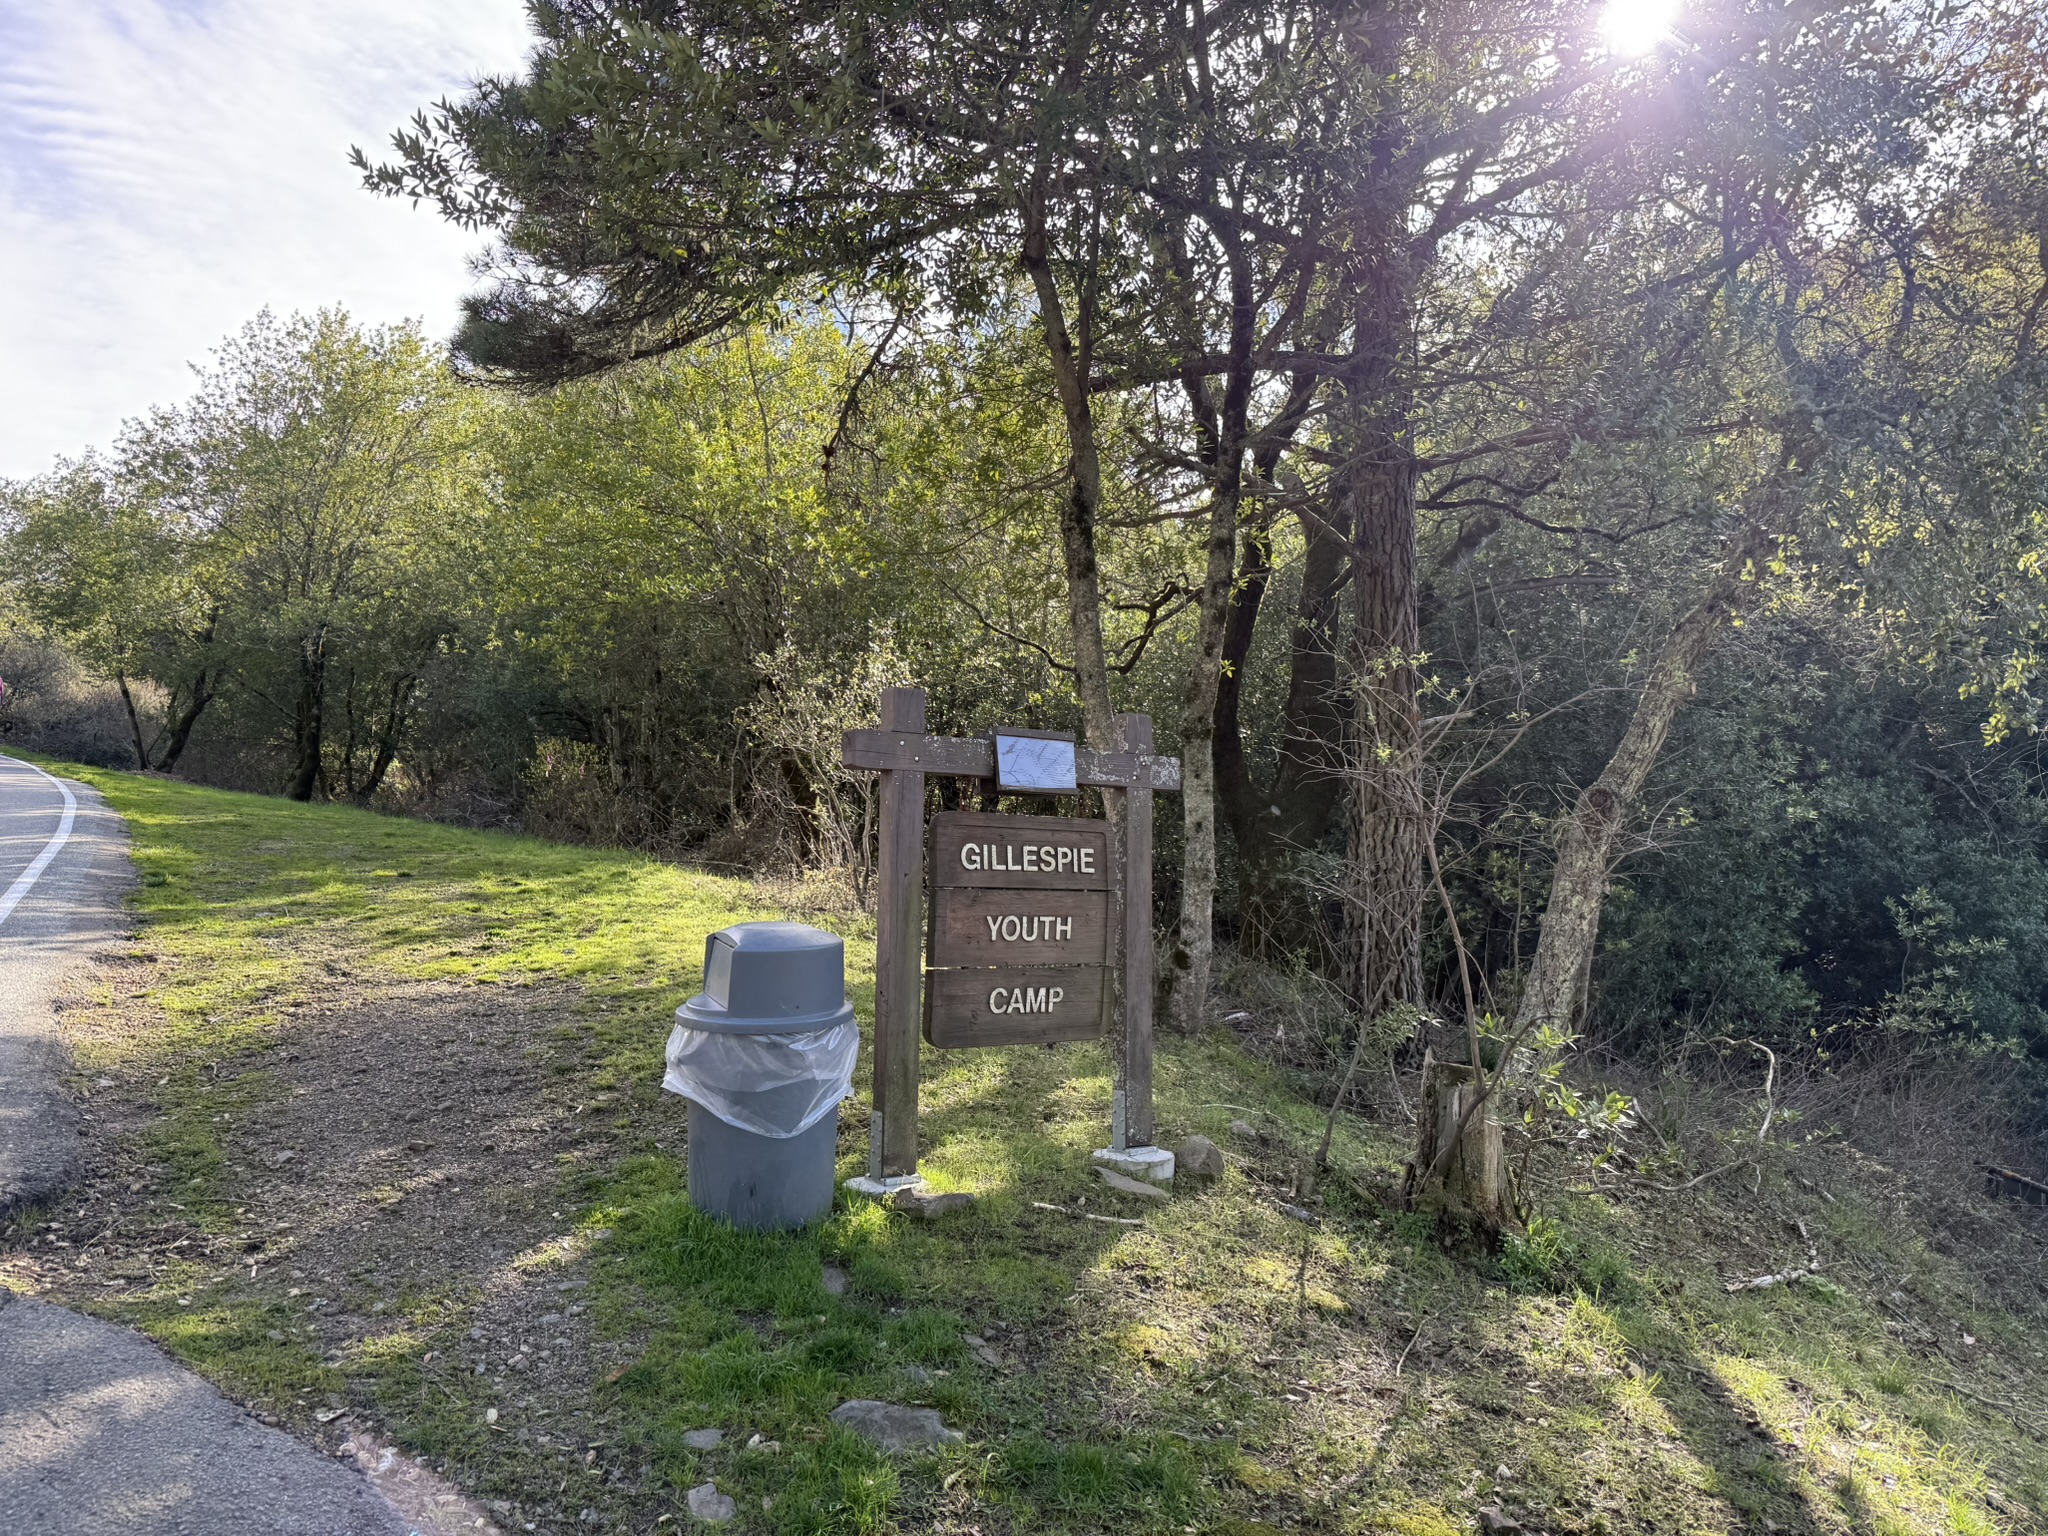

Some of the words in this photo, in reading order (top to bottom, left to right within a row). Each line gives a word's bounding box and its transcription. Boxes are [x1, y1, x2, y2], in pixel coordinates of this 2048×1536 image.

[960, 843, 1096, 873] GILLESPIE
[986, 915, 1072, 942] YOUTH
[989, 986, 1064, 1014] CAMP
